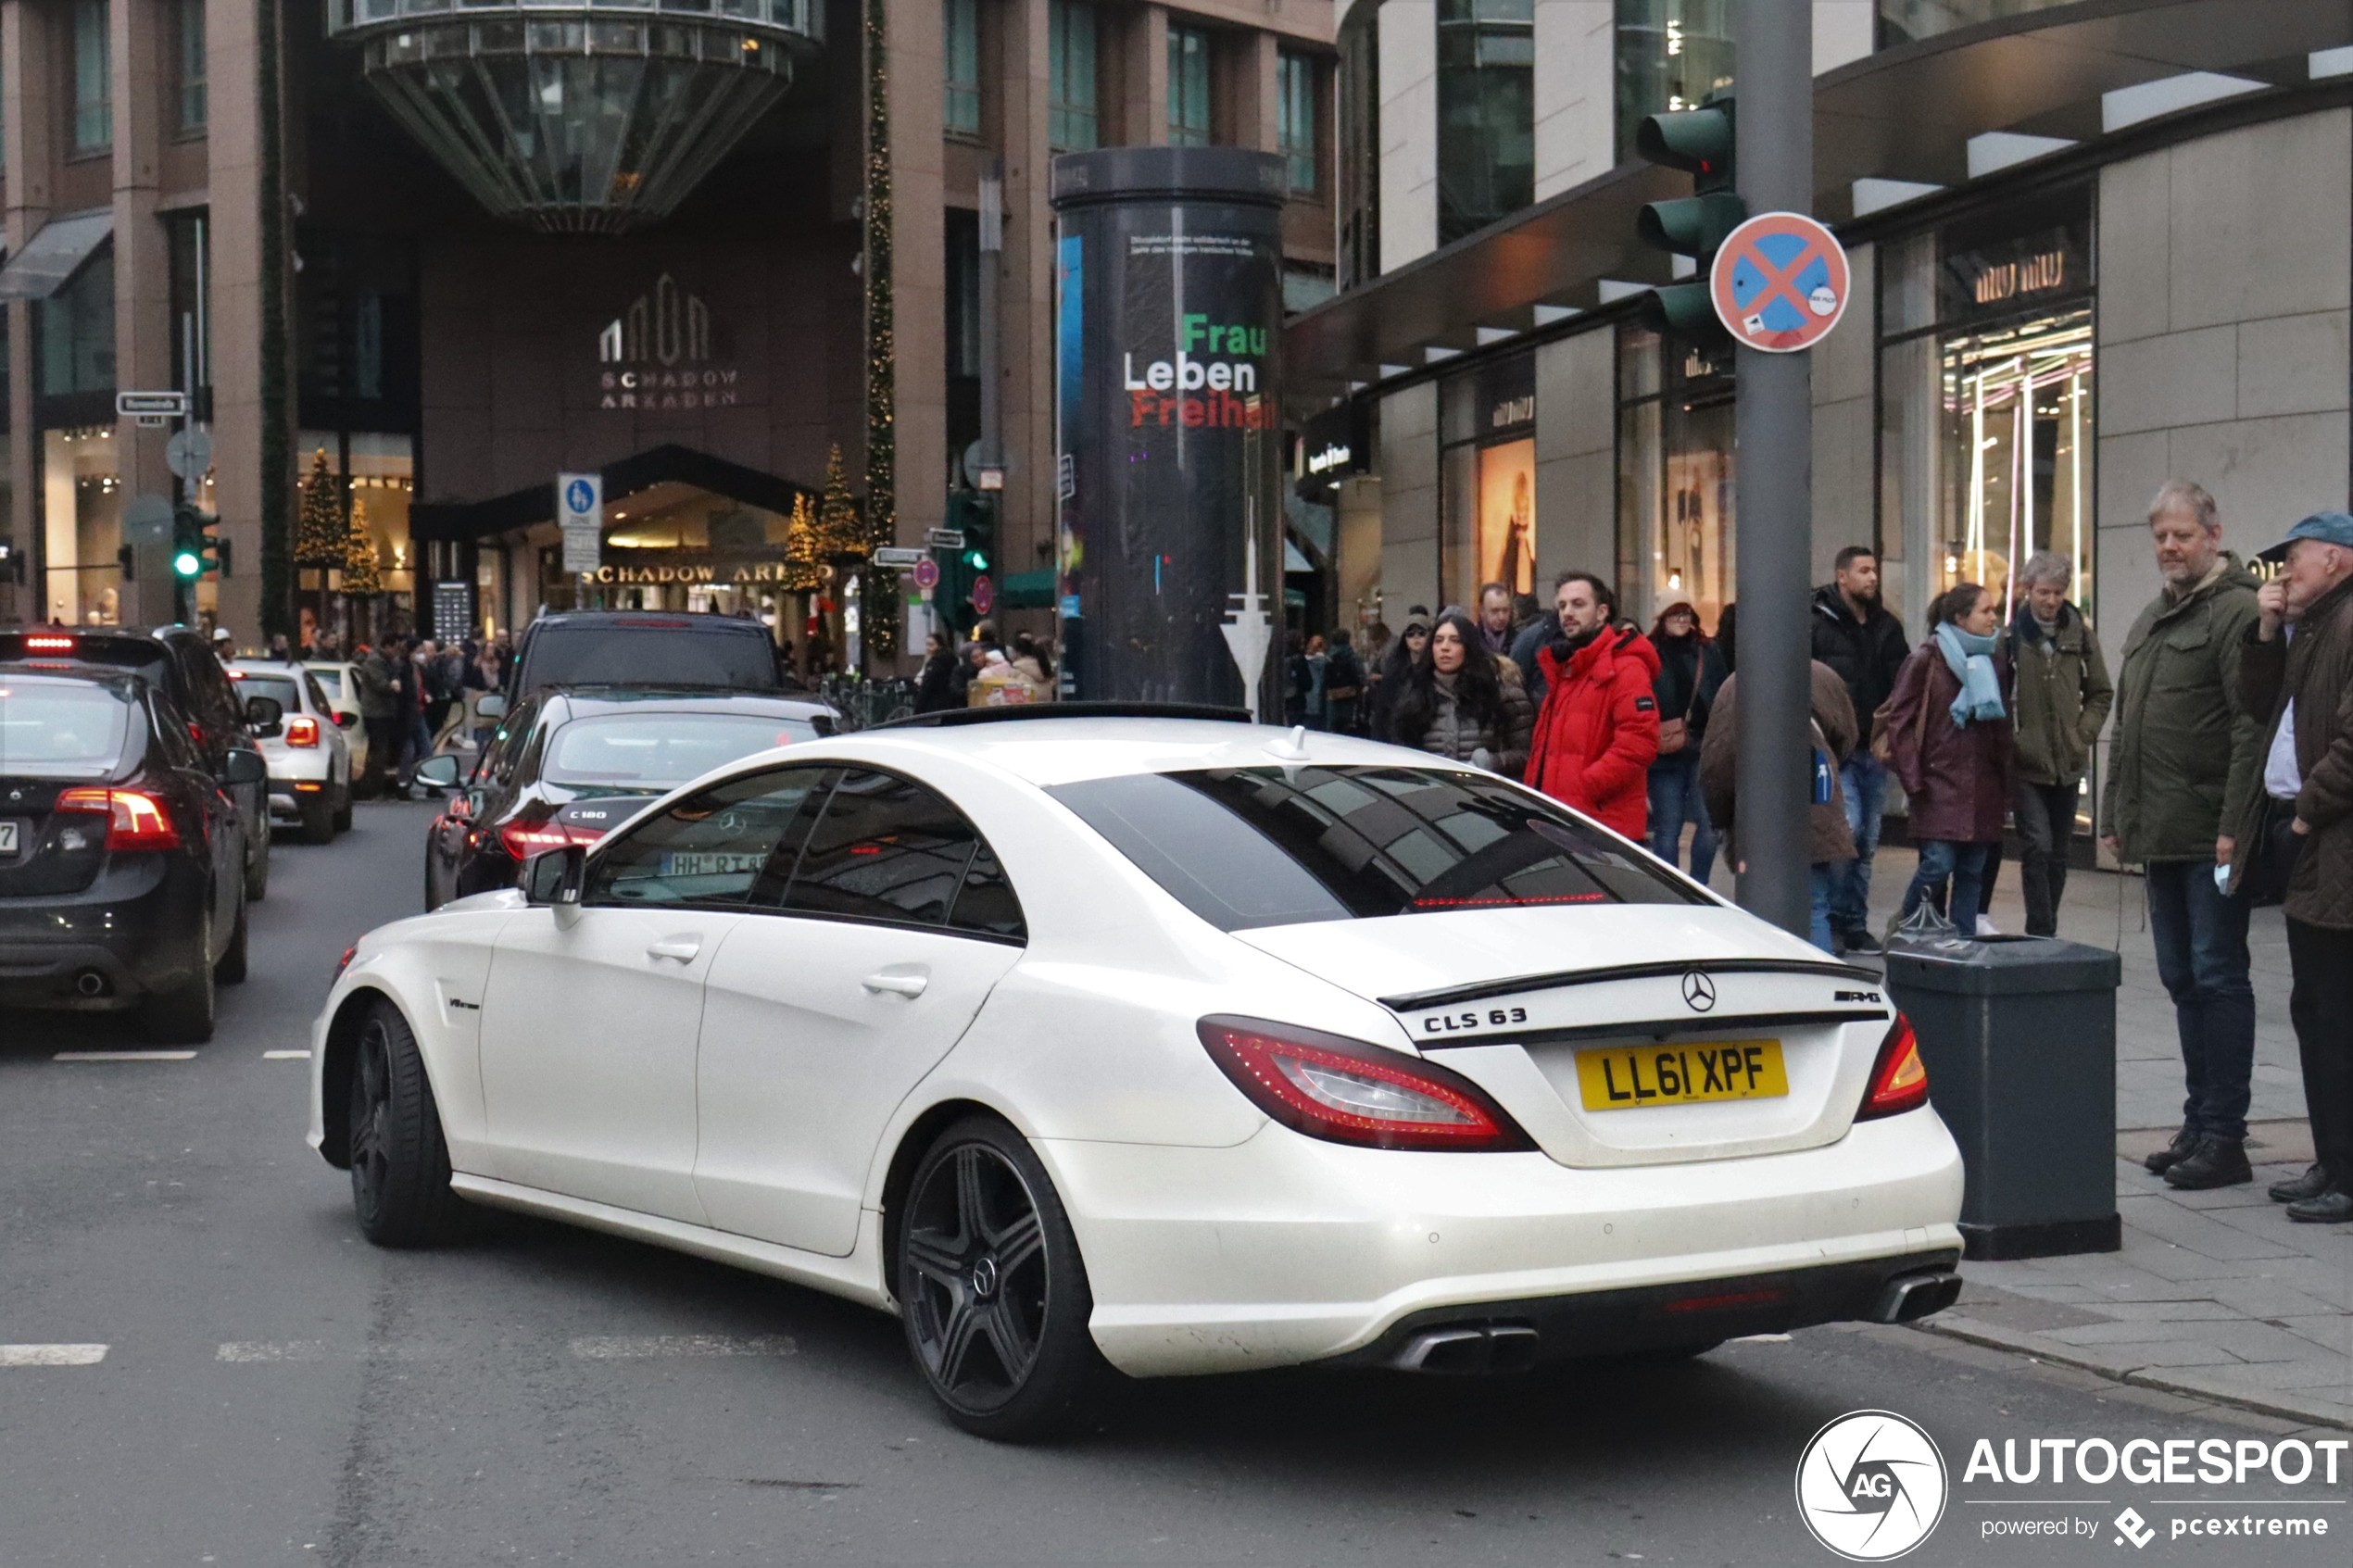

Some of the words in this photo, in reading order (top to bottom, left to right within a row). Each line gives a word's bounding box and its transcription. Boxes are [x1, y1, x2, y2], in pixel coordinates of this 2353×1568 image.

[1183, 313, 1266, 356] Frau
[600, 370, 738, 389] SCHADOW
[1124, 350, 1255, 392] Leben
[600, 391, 738, 408] ARKADEN
[570, 810, 579, 819] C
[581, 810, 607, 819] 180
[674, 856, 701, 874] HH
[1850, 991, 1881, 1003] AMG
[1424, 1012, 1478, 1033] CLS
[1489, 1007, 1528, 1024] 63
[1603, 1051, 1692, 1101] LL61
[1698, 1047, 1764, 1093] XPF
